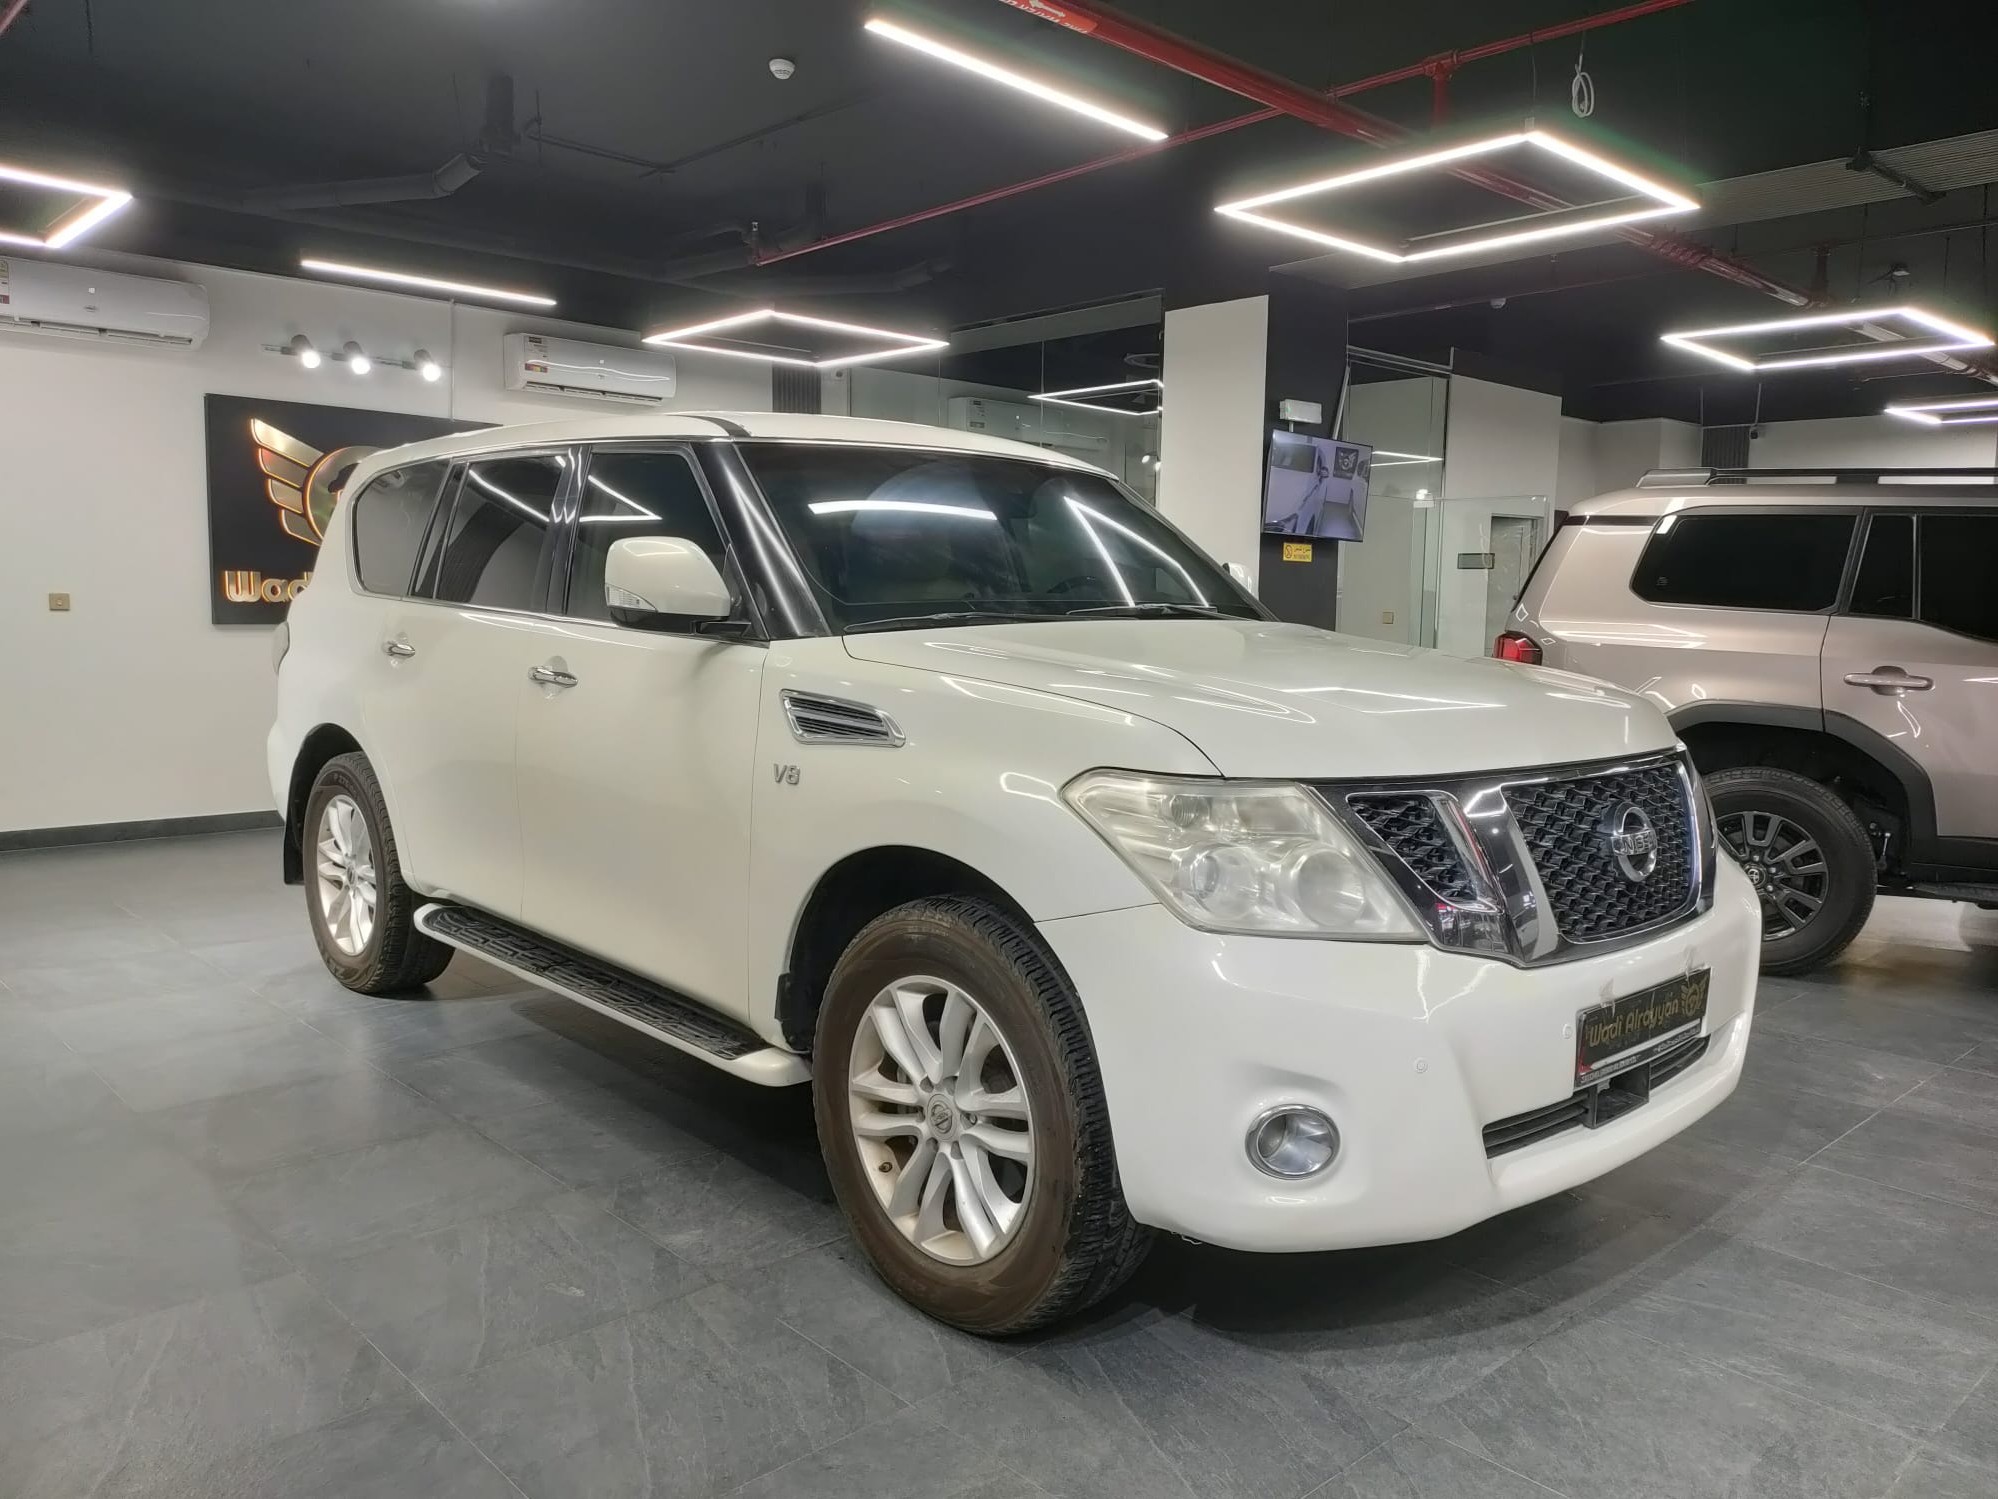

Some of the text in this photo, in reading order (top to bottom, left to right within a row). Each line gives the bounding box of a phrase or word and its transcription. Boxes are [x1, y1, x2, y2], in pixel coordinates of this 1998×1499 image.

[773, 763, 801, 786] V8
[1589, 1015, 1622, 1047] Wadi
[1625, 997, 1679, 1031] Alrayyan
